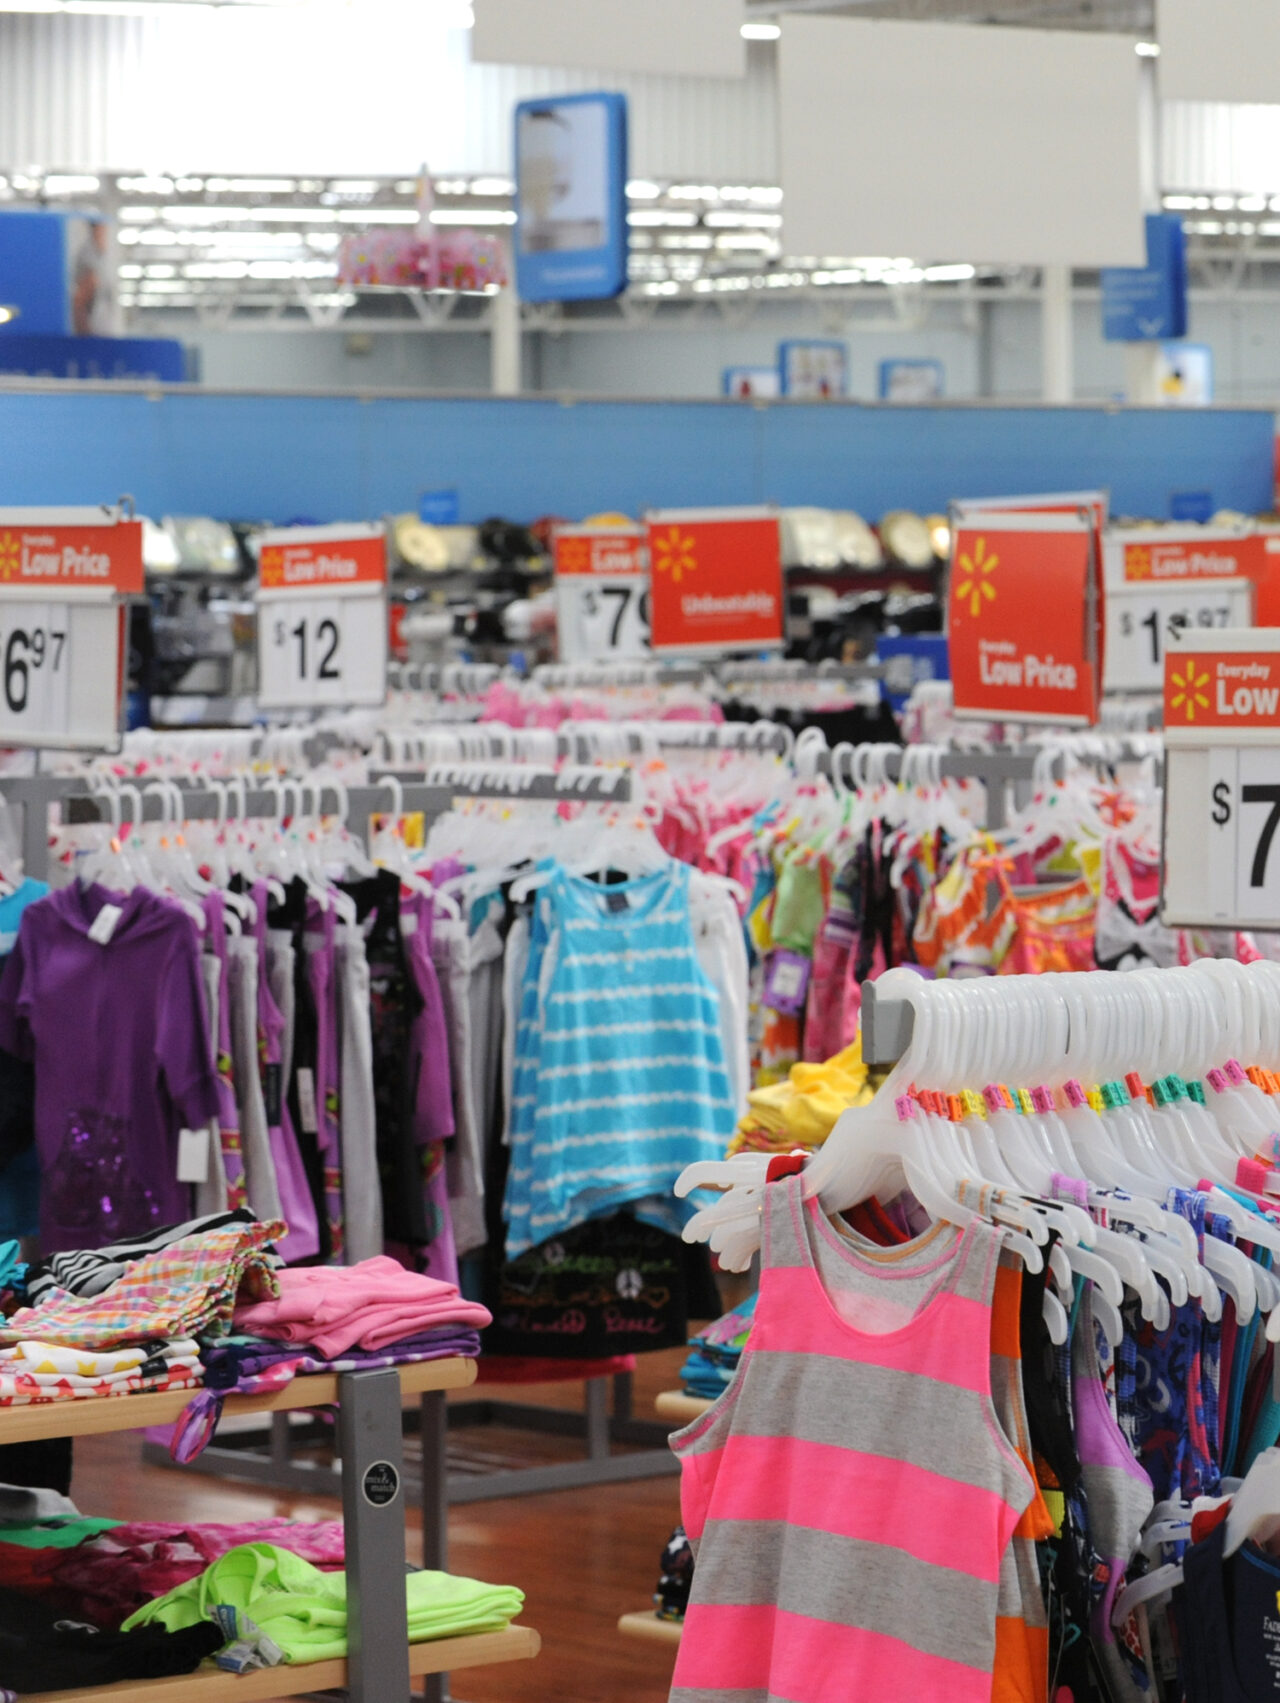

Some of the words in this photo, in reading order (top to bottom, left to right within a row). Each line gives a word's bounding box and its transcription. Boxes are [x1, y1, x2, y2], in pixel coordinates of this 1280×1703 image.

[22, 548, 60, 577] Low
[62, 546, 111, 577] Price
[284, 560, 315, 583] Low
[316, 555, 358, 579] Price
[1151, 551, 1184, 577] Low
[1187, 549, 1237, 576] Price
[980, 656, 1022, 687] Low
[1024, 655, 1077, 690] Price
[1216, 663, 1271, 682] Everyday
[1216, 679, 1280, 716] Low
